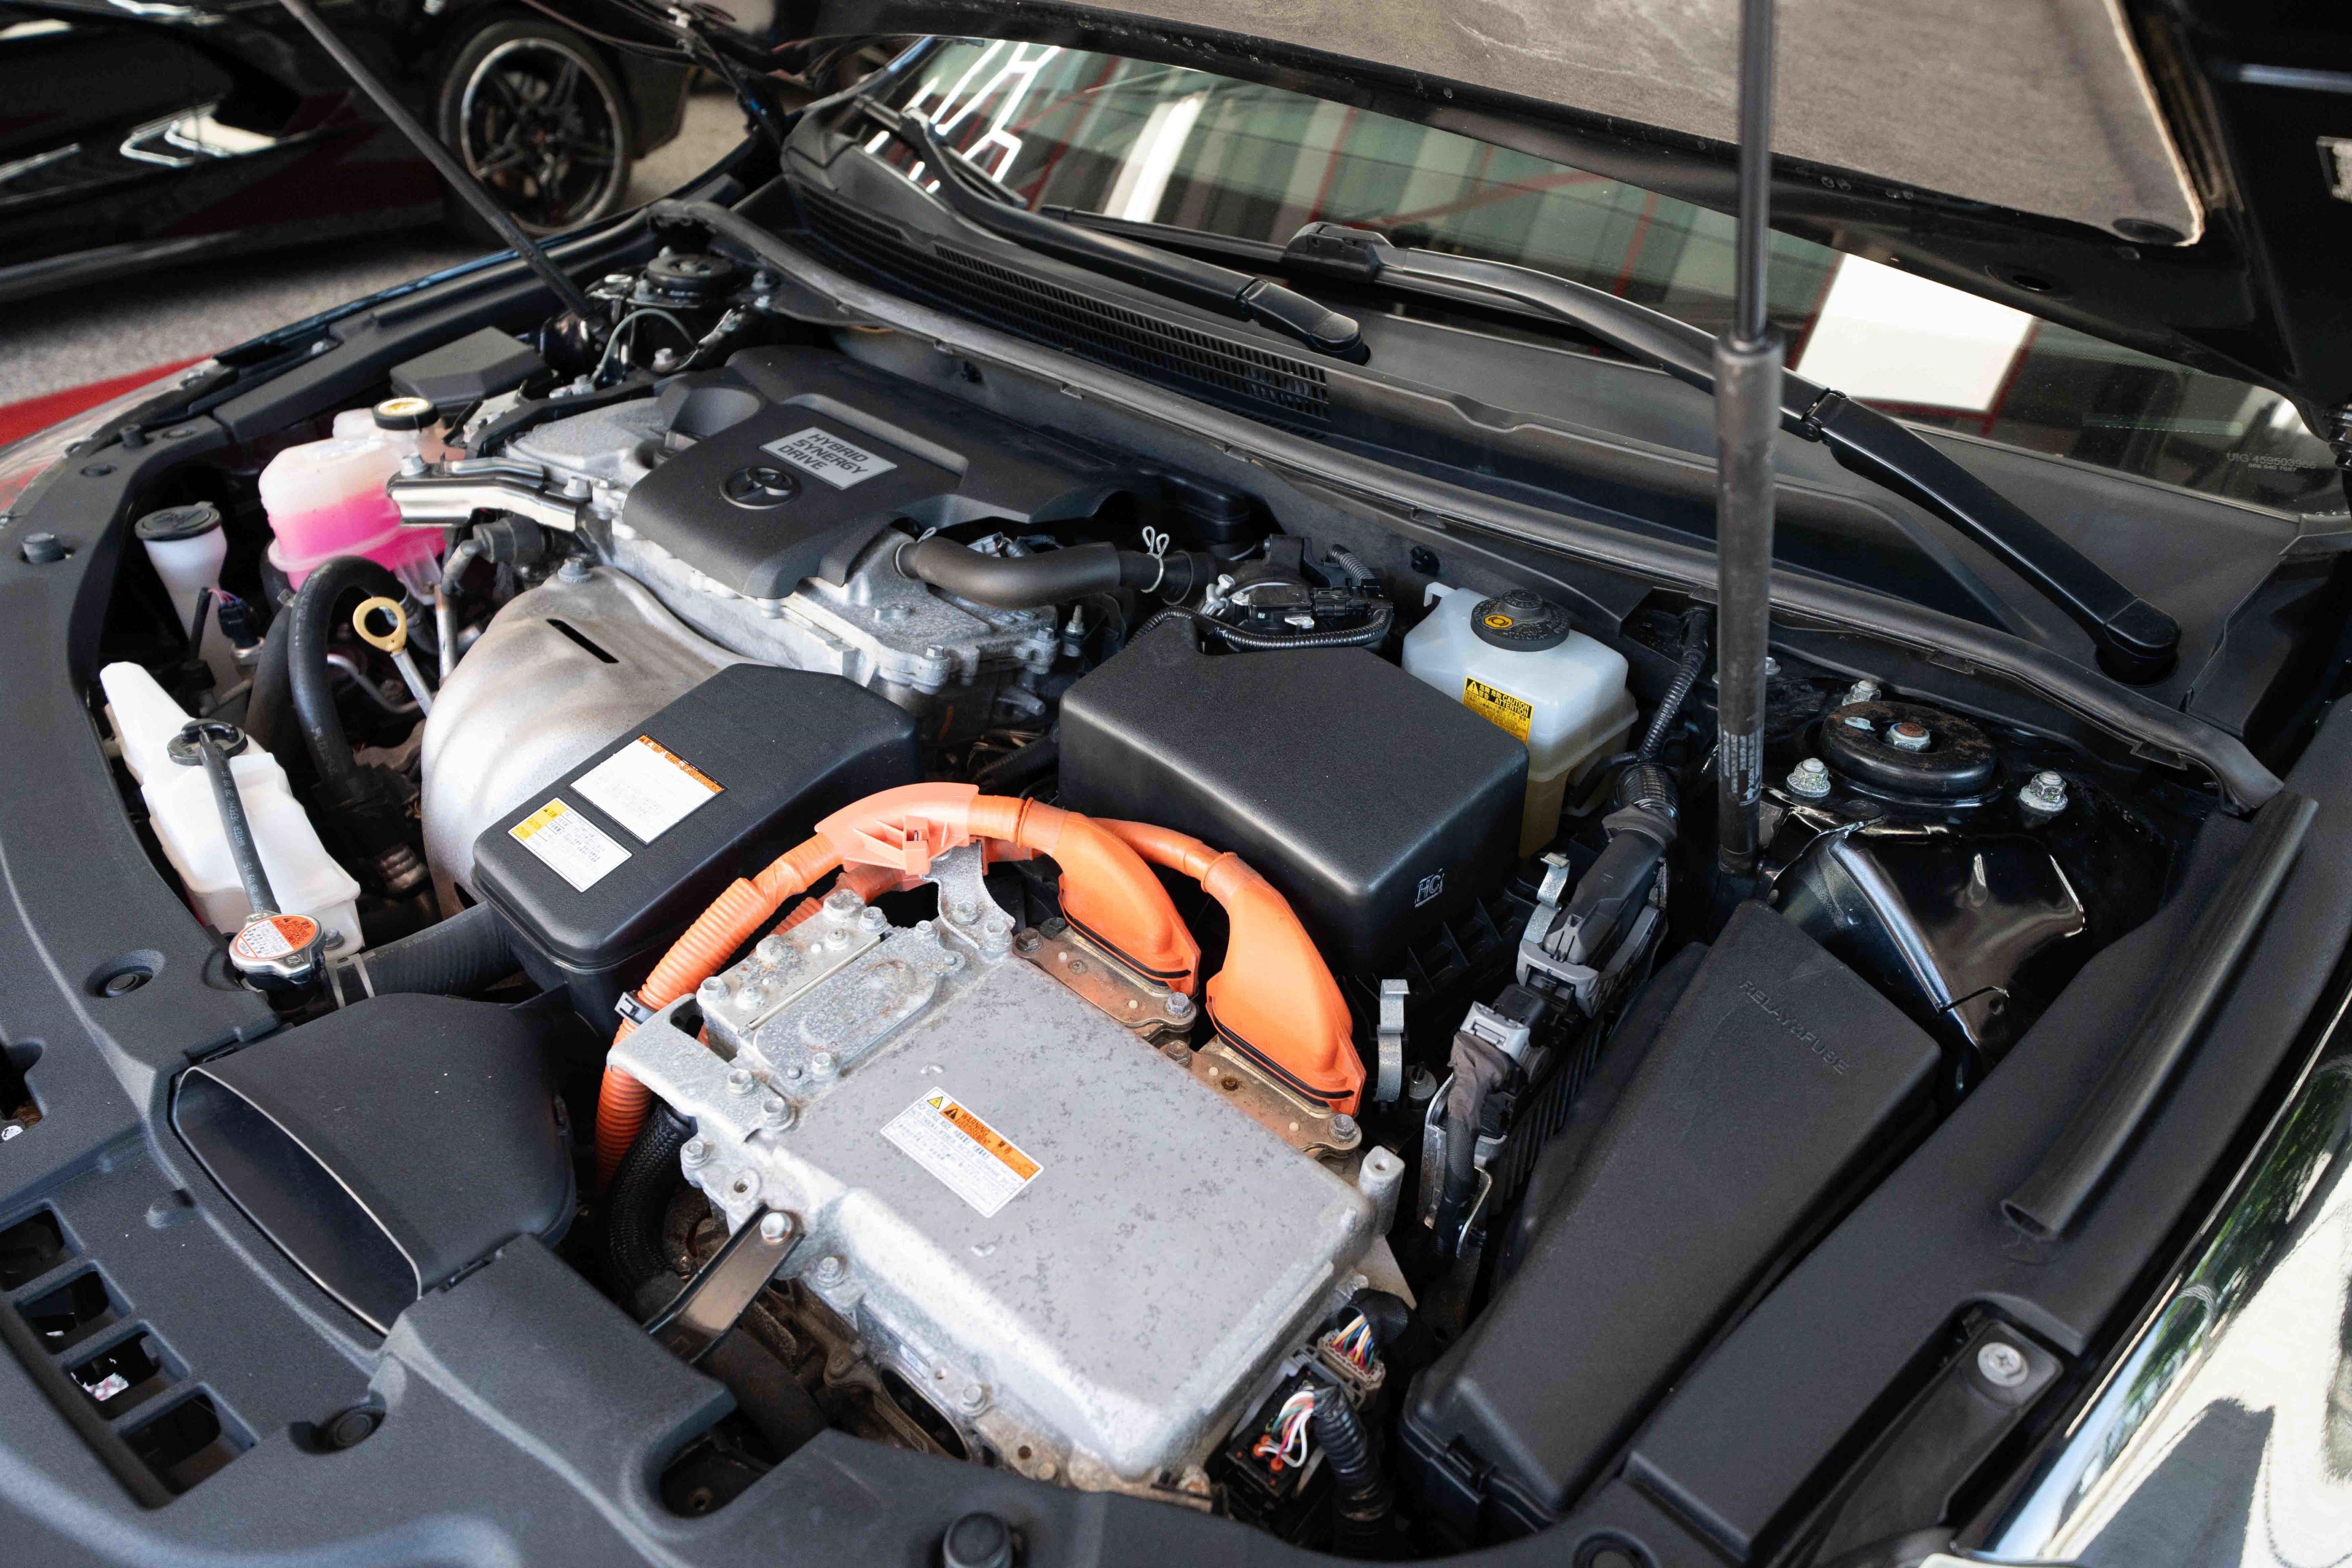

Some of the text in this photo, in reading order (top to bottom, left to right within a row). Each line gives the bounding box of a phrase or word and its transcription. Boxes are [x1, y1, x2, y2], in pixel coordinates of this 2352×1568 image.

[777, 444, 828, 470] DRIVE
[792, 439, 868, 474] SYNERGY
[808, 433, 869, 462] HYBRID
[1494, 698, 1528, 716] ATTENTION
[1503, 694, 1529, 710] CAUTION
[234, 826, 247, 847] WATER
[1417, 875, 1441, 902] HC
[961, 1113, 990, 1136] WARNING
